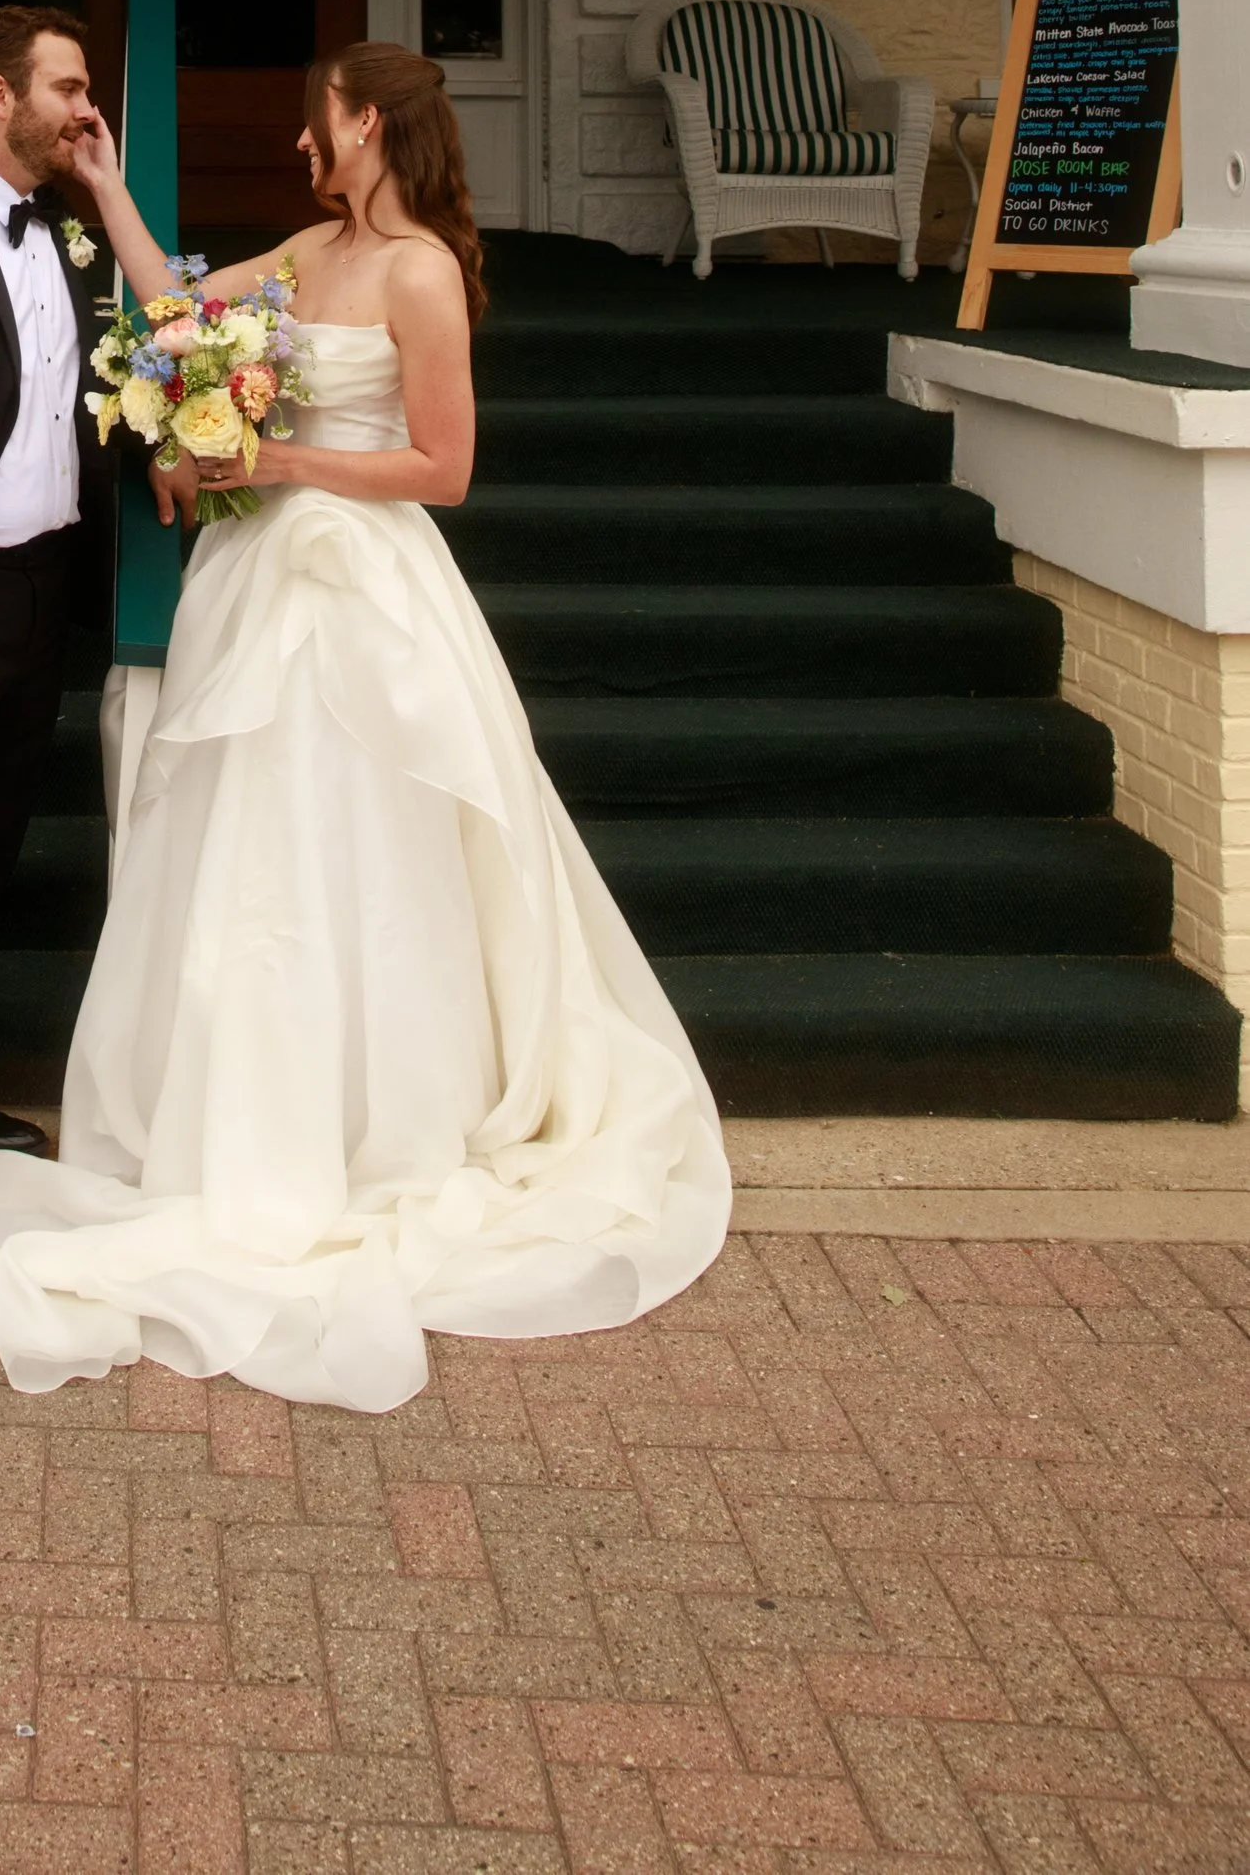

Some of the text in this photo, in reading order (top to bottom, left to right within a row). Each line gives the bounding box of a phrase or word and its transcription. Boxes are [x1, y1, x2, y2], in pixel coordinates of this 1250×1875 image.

[1076, 26, 1104, 38] State
[1109, 22, 1148, 34] Avocado
[1076, 72, 1110, 82] Caesar
[1114, 70, 1146, 82] Salad
[1086, 106, 1122, 117] Waffle
[1014, 142, 1104, 158] Jalapeño Bacon
[1012, 160, 1130, 177] ROSE ROOM BAR
[1008, 182, 1032, 194] Open
[1038, 182, 1062, 196] daily
[1004, 198, 1093, 212] Social District
[1002, 216, 1109, 234] TO GO DRINKS
